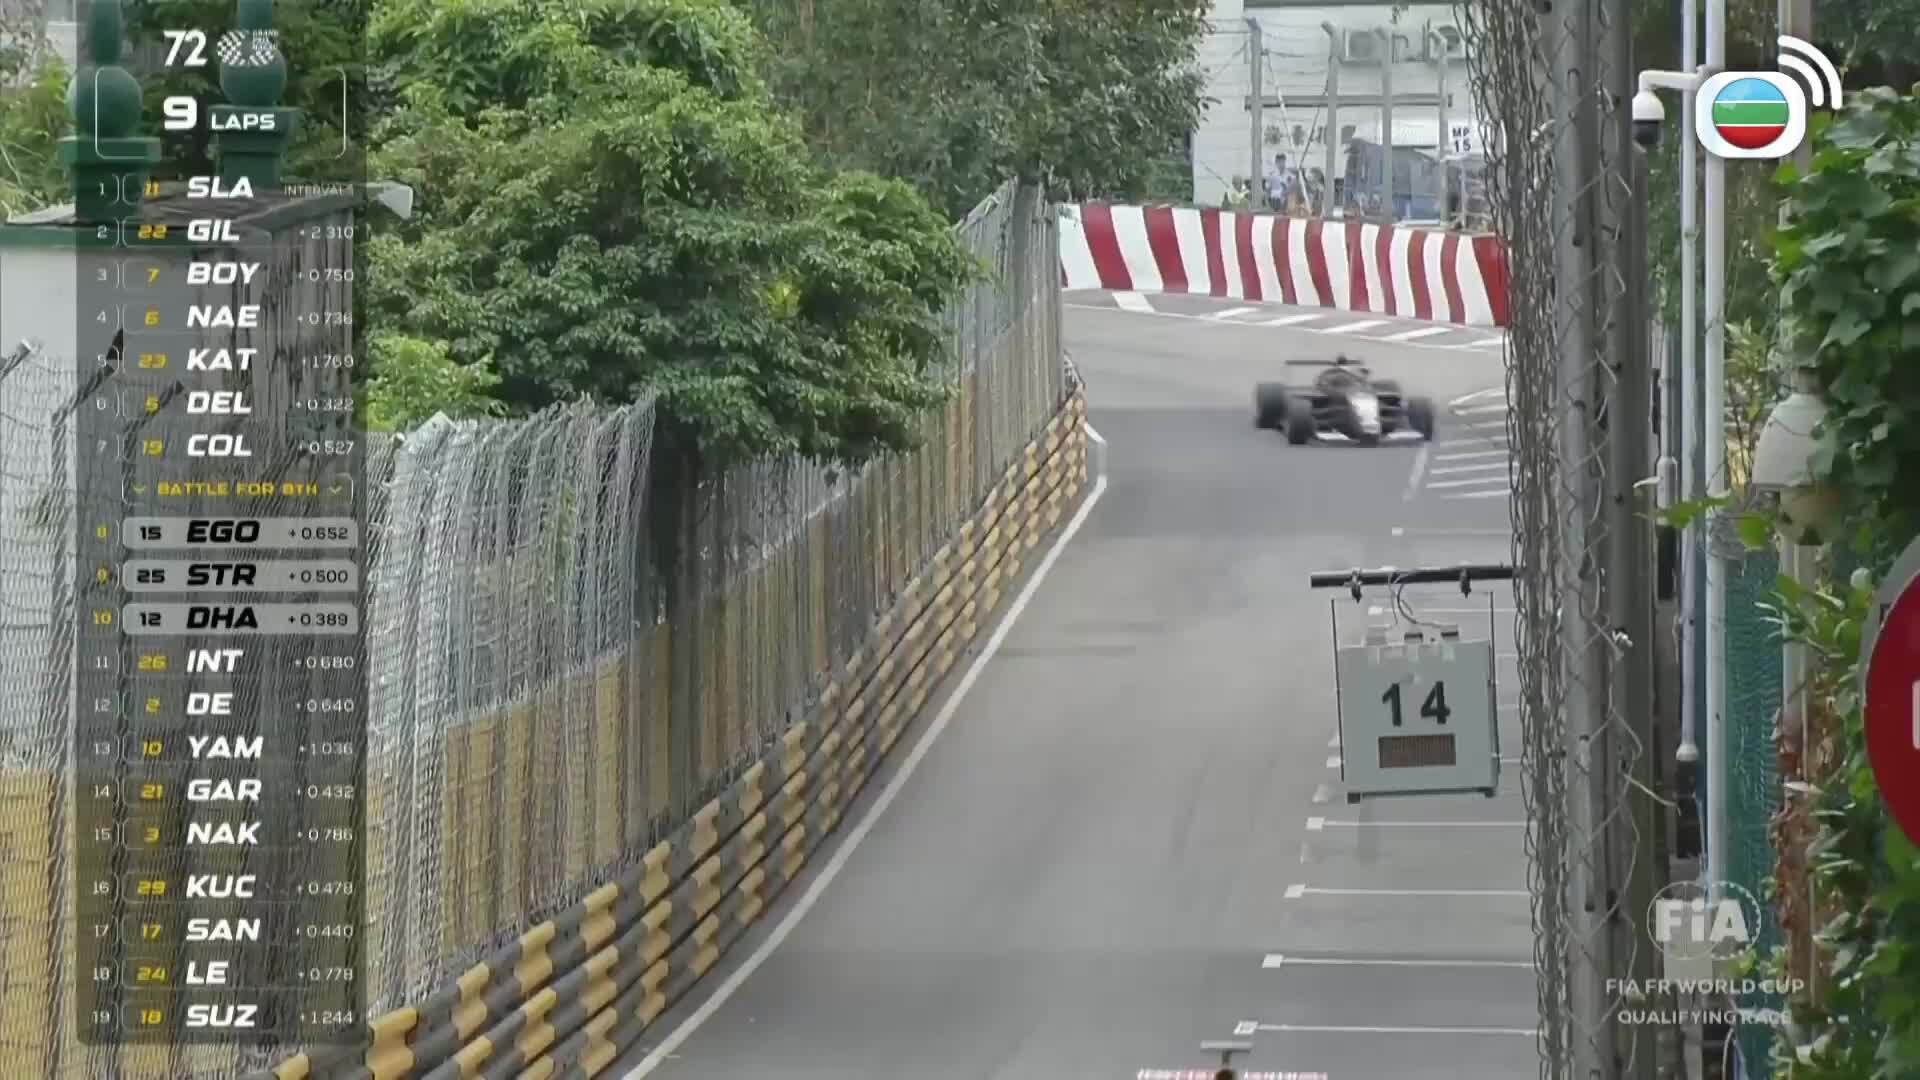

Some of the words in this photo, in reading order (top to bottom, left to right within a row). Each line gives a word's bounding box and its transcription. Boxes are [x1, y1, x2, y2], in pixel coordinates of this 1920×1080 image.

[1452, 127, 1471, 137] MP
[1455, 138, 1472, 153] 15
[1382, 680, 1451, 727] 14
